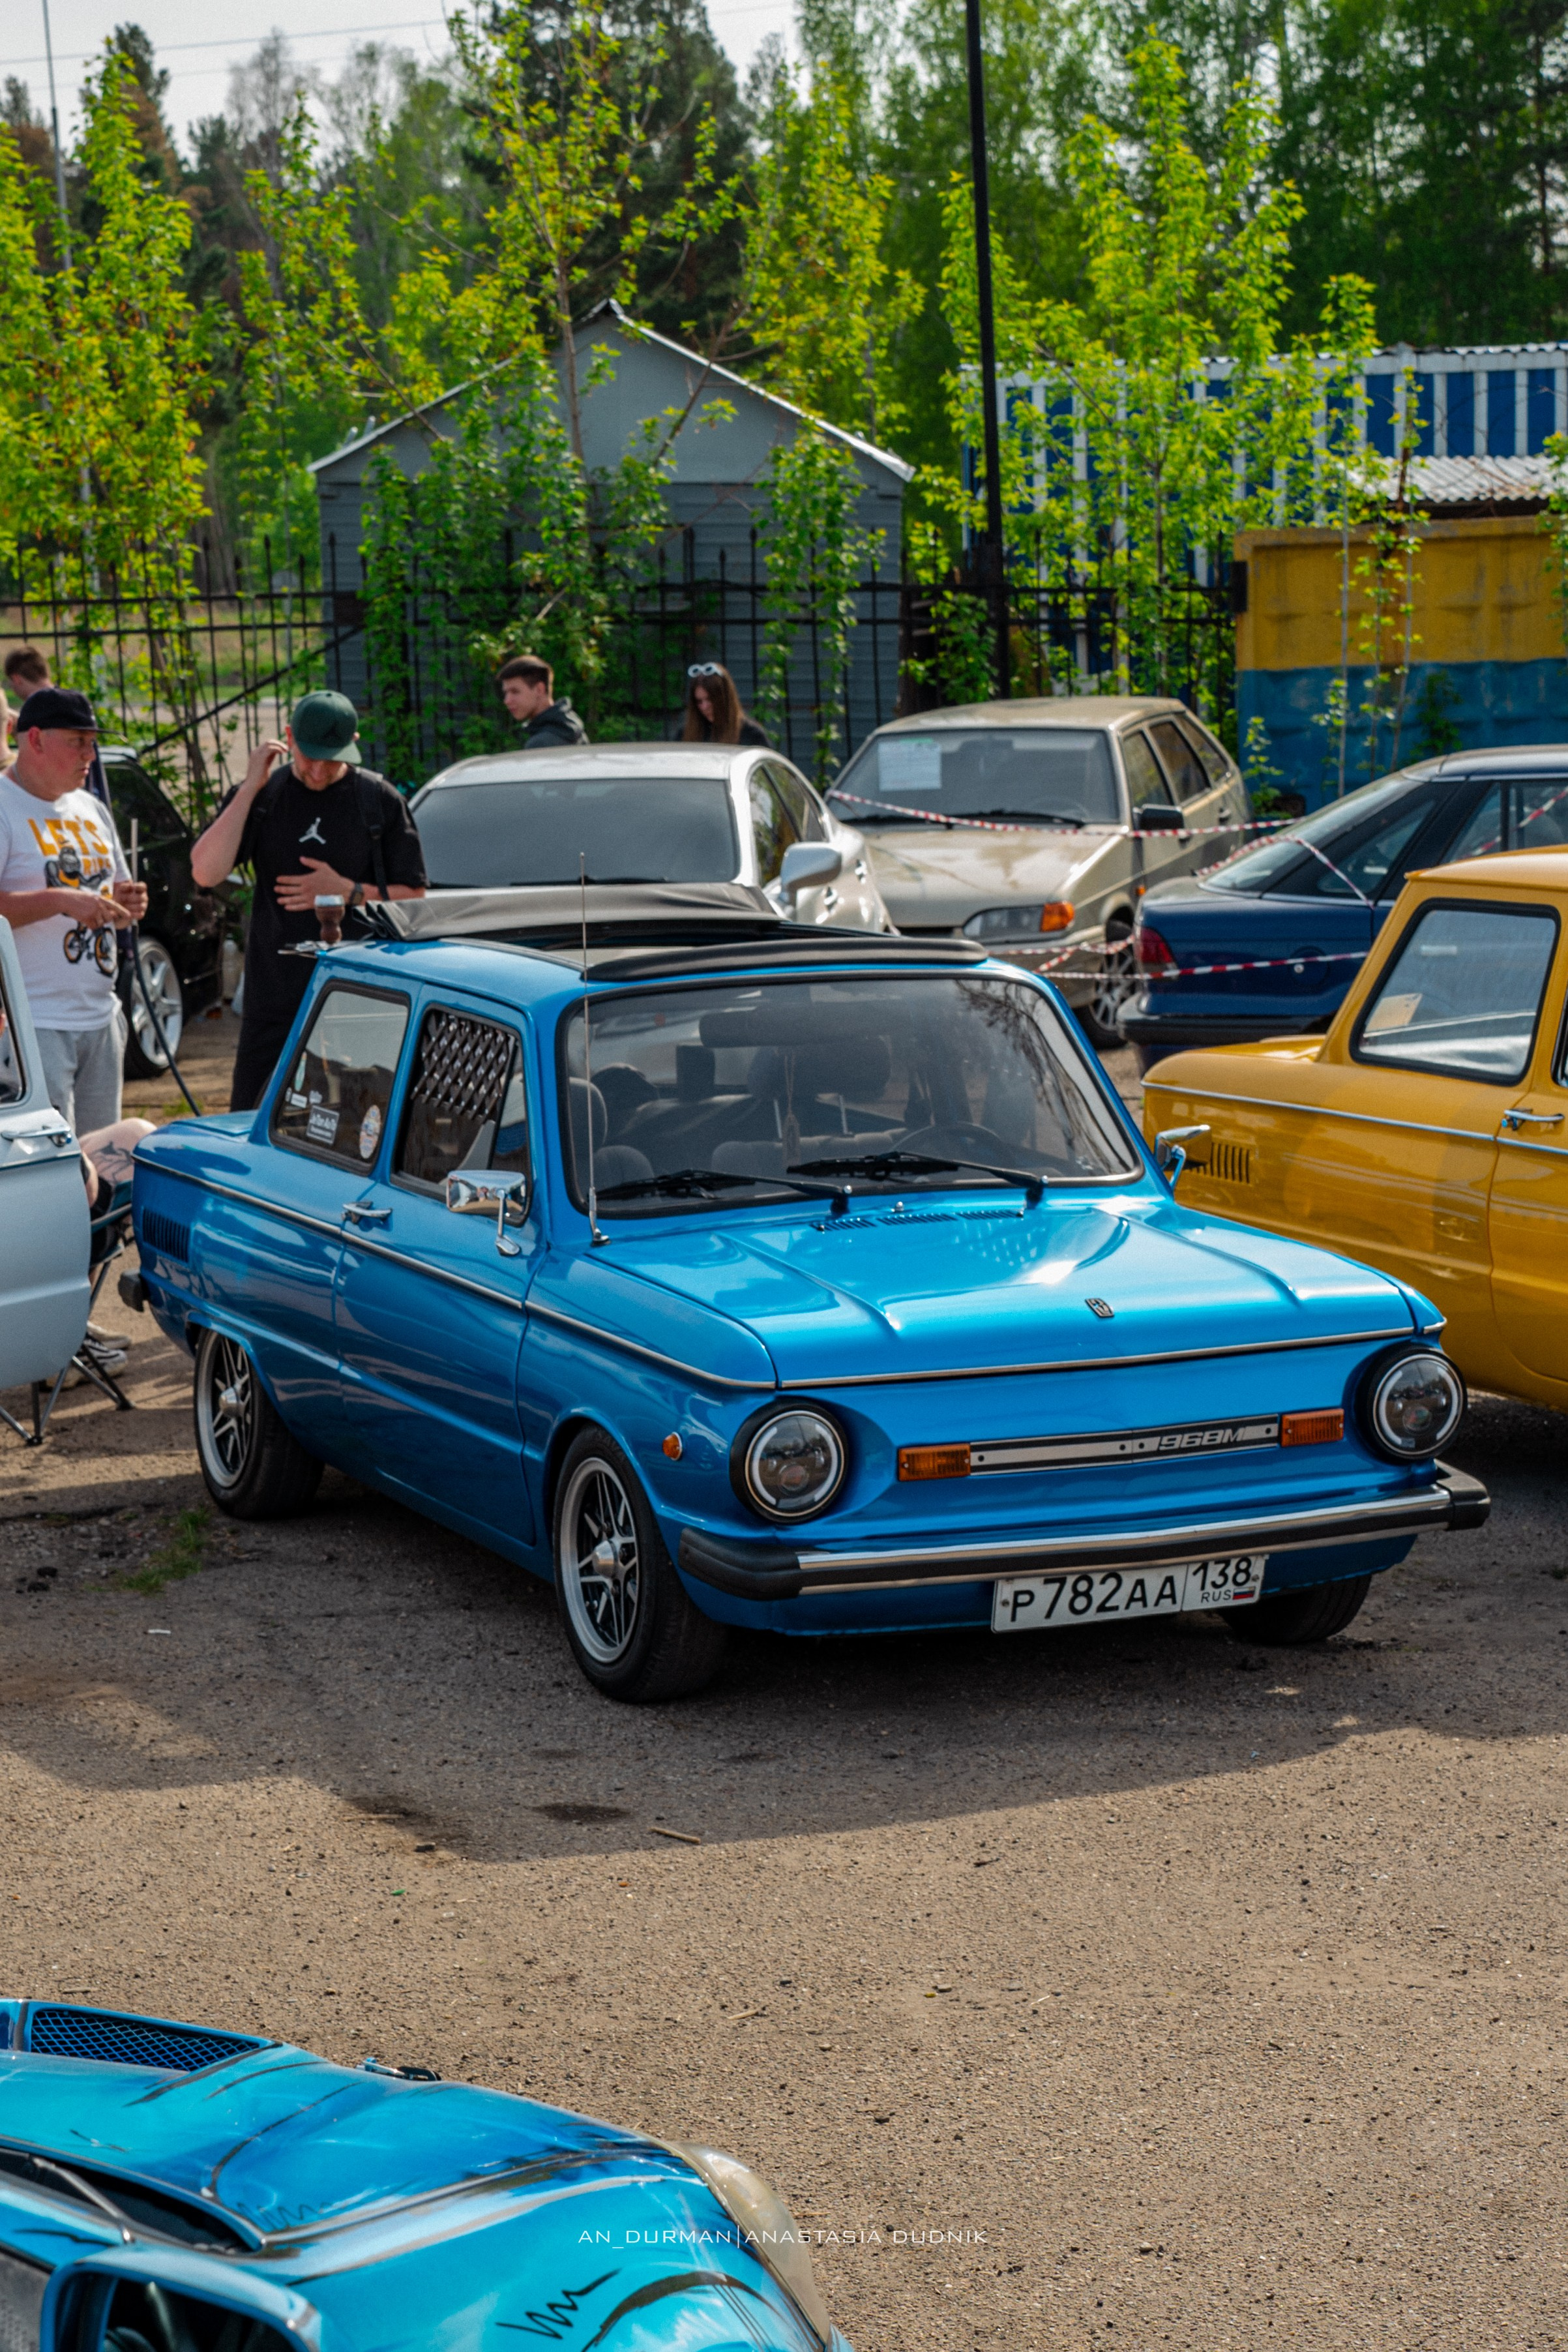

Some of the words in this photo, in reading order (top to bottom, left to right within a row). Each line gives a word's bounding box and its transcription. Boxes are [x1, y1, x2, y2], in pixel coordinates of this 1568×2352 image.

[27, 814, 109, 857] LET'S
[1192, 1556, 1252, 1591] 138
[1200, 1590, 1232, 1603] RUS
